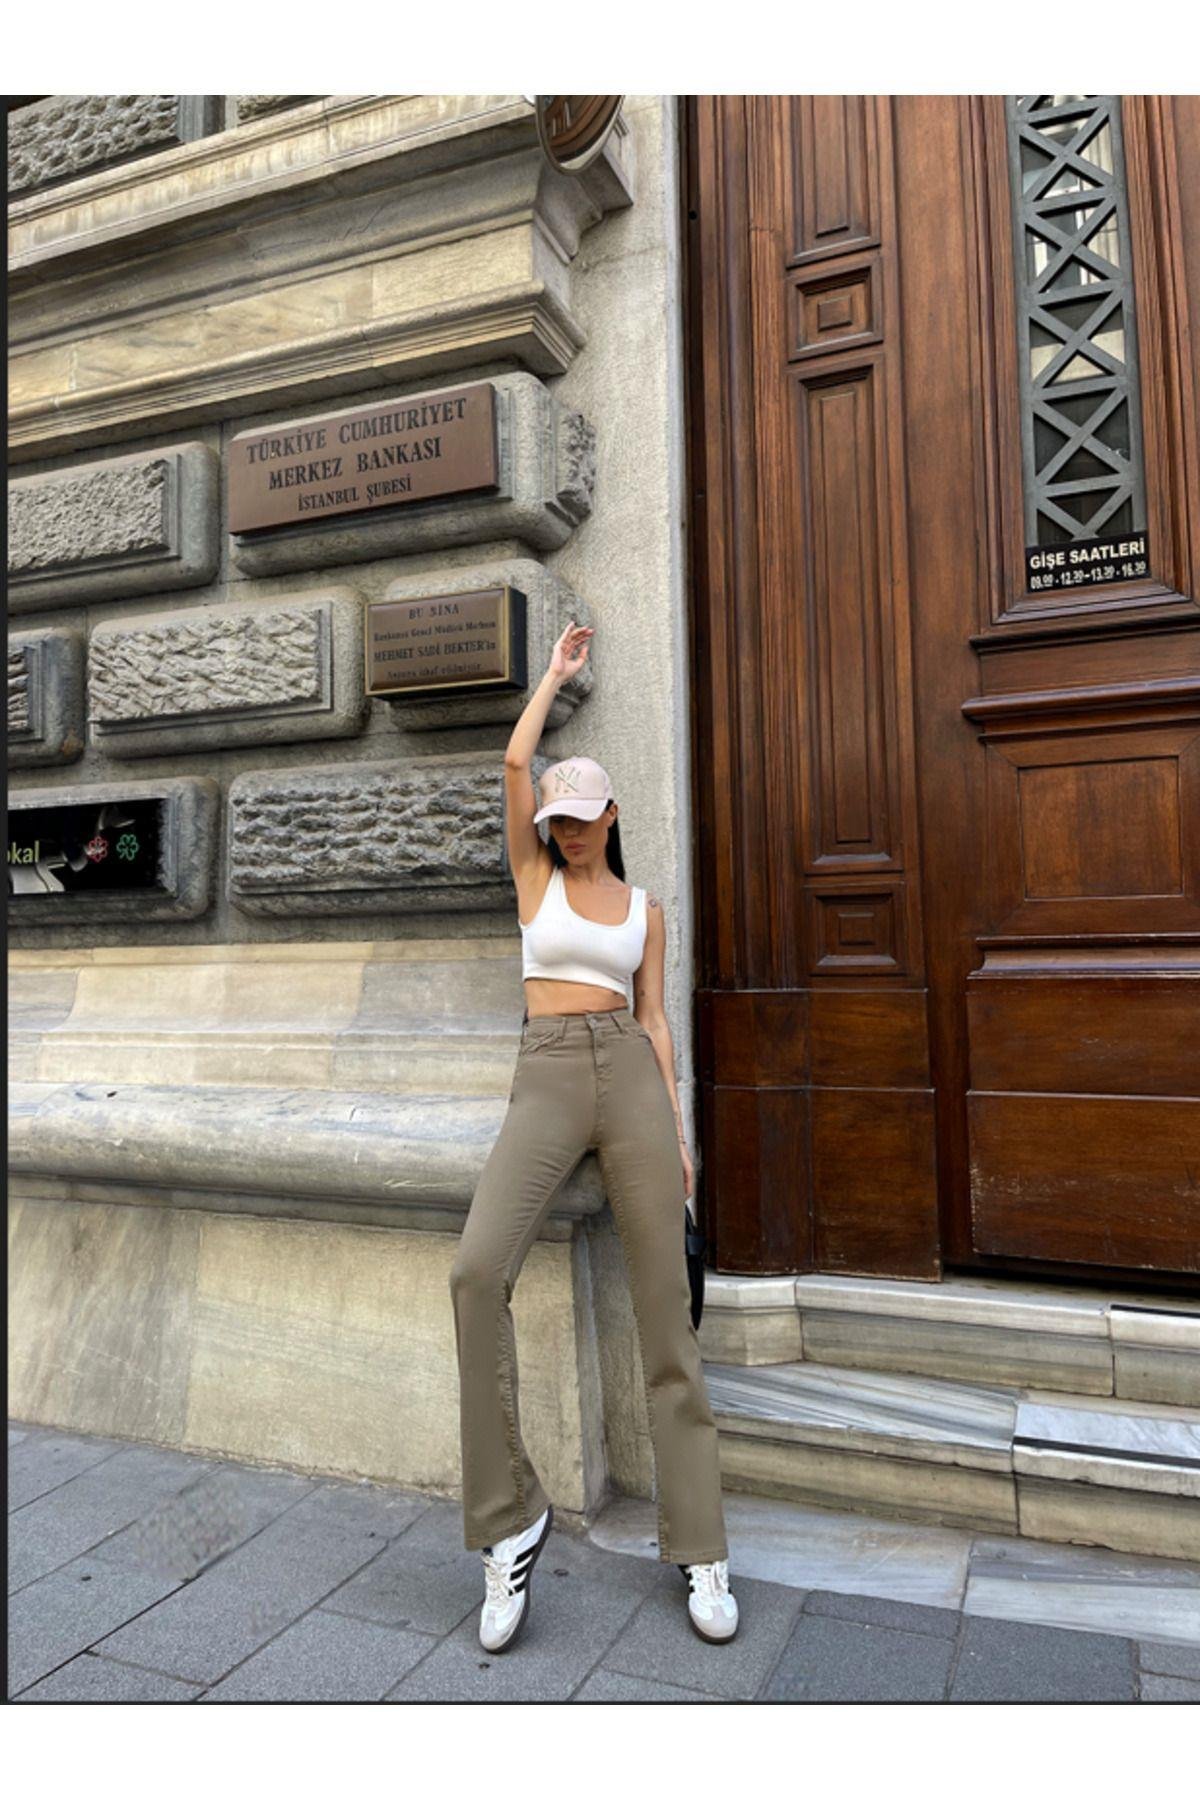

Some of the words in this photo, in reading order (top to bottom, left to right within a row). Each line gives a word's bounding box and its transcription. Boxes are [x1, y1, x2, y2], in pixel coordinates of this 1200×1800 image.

[246, 428, 327, 464] TÜRKİYE
[339, 398, 467, 444] CUMHURİYET
[269, 457, 343, 490] MERKEZ
[356, 437, 442, 473] BANKASI
[298, 486, 359, 512] İSTANBUL
[366, 473, 412, 505] ŞUBESİ
[1030, 551, 1066, 570] GİŞE
[1069, 537, 1145, 564] SAATLERİ
